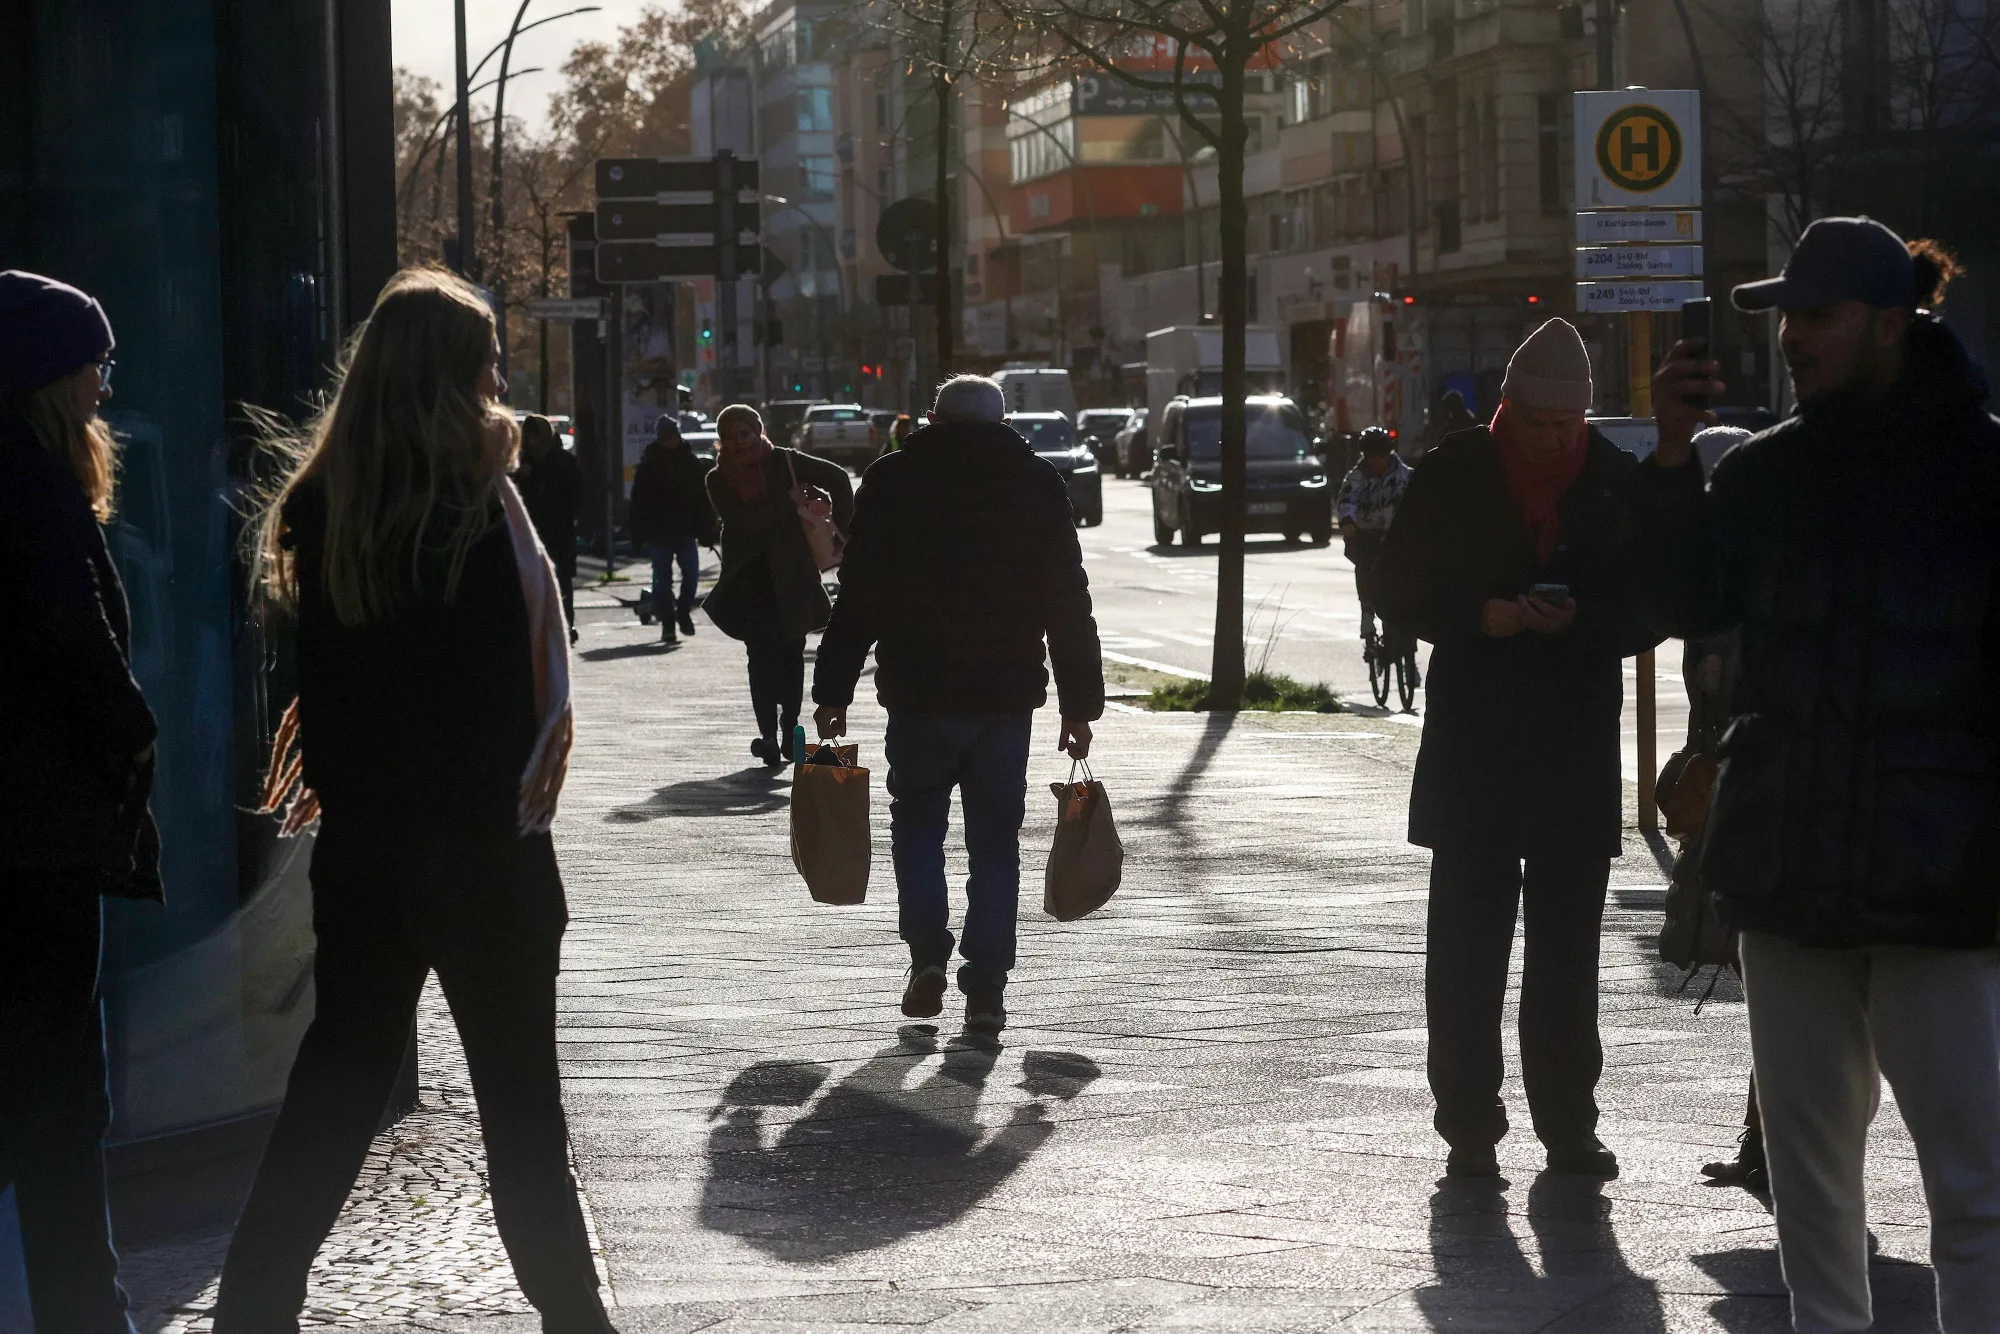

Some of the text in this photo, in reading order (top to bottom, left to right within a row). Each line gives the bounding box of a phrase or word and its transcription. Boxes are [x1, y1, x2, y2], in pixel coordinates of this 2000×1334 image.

[1620, 126, 1659, 171] H
[1605, 219, 1666, 227] Kurfürstendamm
[1594, 253, 1612, 264] 204
[1616, 252, 1648, 260] S+U-Bhf
[1596, 289, 1614, 299] 249
[1618, 287, 1649, 295] S+U-Bhf
[1649, 297, 1675, 305] Garten
